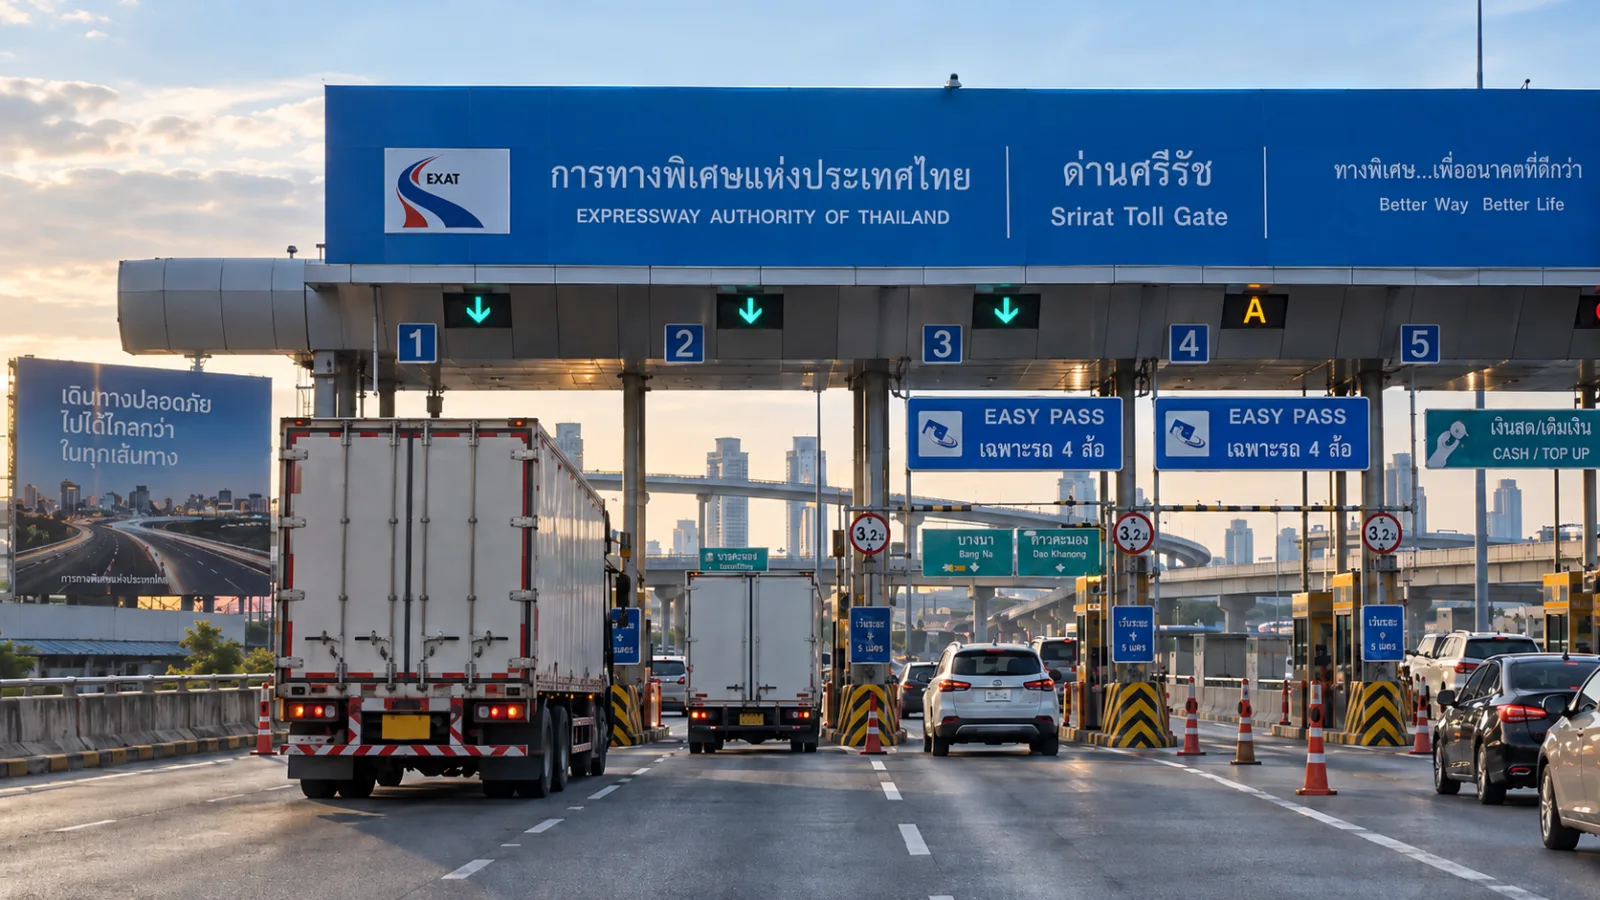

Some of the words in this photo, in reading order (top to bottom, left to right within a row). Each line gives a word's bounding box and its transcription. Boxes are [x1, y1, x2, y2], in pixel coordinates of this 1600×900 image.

[426, 173, 460, 184] EXAT
[551, 155, 970, 190] การทางพิเศษแห่งประเทศไทย
[1063, 149, 1213, 187] ด่านศรีรัช
[1334, 151, 1582, 180] ทางพิเศษ...เพื่ออนาคตที่ดีกว่า
[577, 209, 701, 224] EXPRESSWAY
[710, 209, 816, 225] AUTHORITY
[825, 209, 850, 225] OF
[858, 210, 950, 225] THAILAND
[1051, 206, 1114, 226] Srirat
[1124, 206, 1164, 226] Toll
[1174, 206, 1228, 226] Gate
[1379, 197, 1427, 212] Better
[1435, 197, 1469, 215] Way
[1483, 197, 1530, 212] Better
[1537, 197, 1565, 212] Life
[1243, 297, 1267, 324] A
[409, 329, 424, 358] 1
[675, 329, 693, 358] 2
[933, 330, 952, 359] 3
[1178, 330, 1199, 358] 4
[1410, 330, 1430, 359] 5
[61, 385, 212, 414] เดินทางปลอดภัย
[60, 409, 175, 439] ไปได้ไกลกว่า
[985, 408, 1040, 425] EASY
[1050, 408, 1105, 425] PASS
[1229, 408, 1284, 425] EASY
[1293, 408, 1347, 425] PASS
[60, 438, 178, 469] ในทุกเส้นทาง
[980, 442, 1053, 458] เฉพาะรถ
[1061, 440, 1073, 458] 4
[1227, 442, 1300, 458] เฉพาะรถ
[1308, 440, 1320, 458] 4
[1493, 447, 1529, 460] CASH
[1533, 447, 1539, 461] /
[1542, 447, 1568, 460] TOP
[1572, 447, 1590, 460] UP
[959, 549, 980, 560] Bang
[982, 550, 993, 558] Na
[1033, 549, 1049, 559] Dao
[1051, 549, 1087, 560] Khanong
